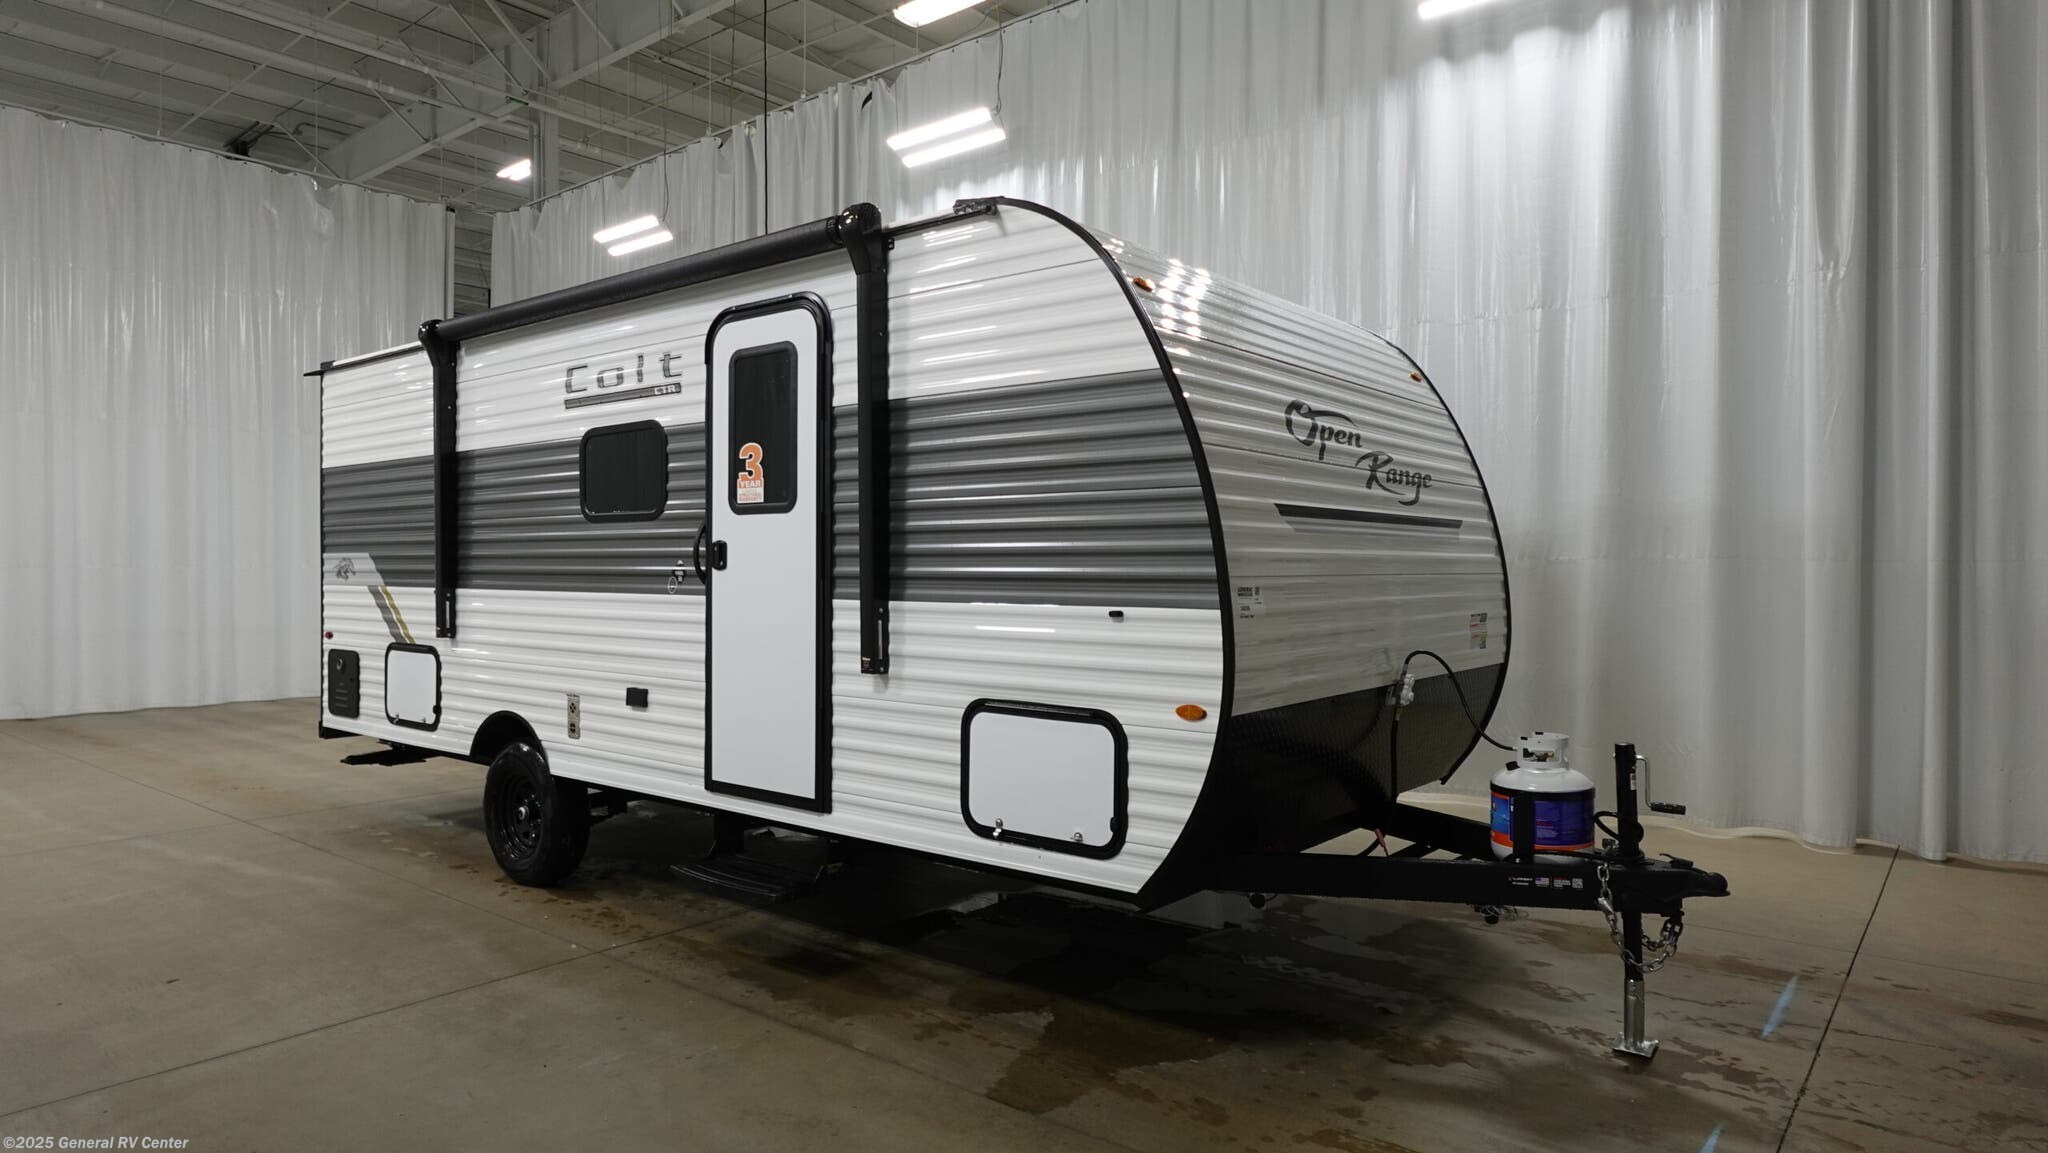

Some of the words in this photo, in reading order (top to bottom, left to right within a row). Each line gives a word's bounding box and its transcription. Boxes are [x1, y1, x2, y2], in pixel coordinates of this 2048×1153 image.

[565, 353, 682, 394] Colt
[654, 384, 677, 396] CTR
[1285, 400, 1363, 460] Open
[739, 442, 763, 480] 3
[1355, 451, 1433, 506] Range
[739, 480, 761, 488] YEAR
